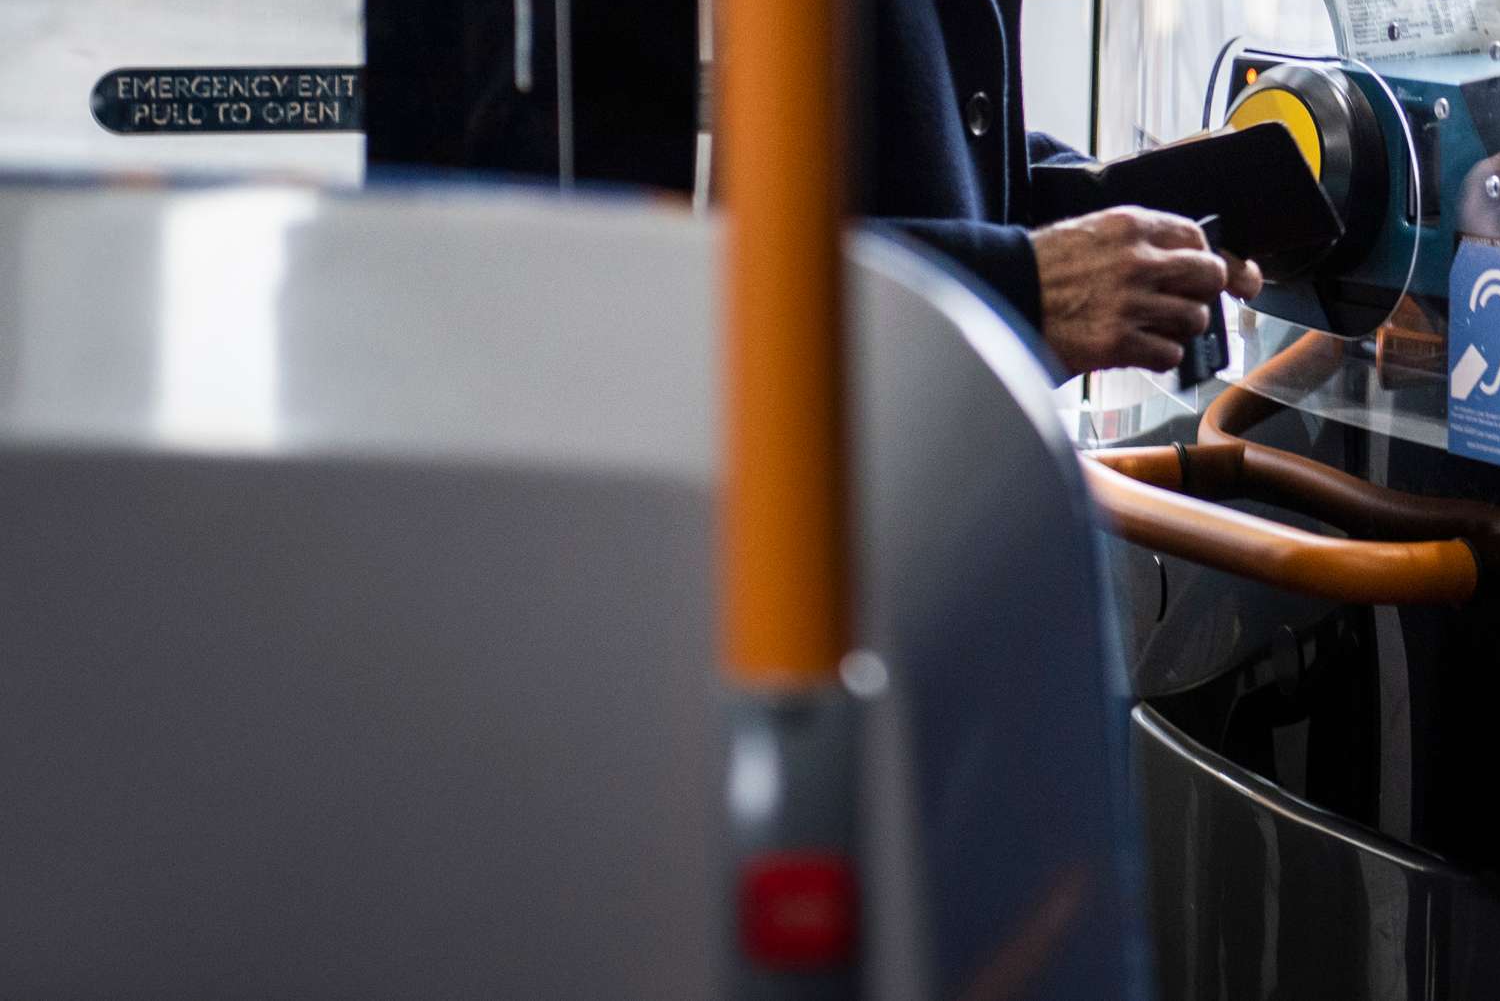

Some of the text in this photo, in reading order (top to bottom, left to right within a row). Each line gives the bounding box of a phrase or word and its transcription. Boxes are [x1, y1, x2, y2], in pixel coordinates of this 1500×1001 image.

[117, 74, 358, 99] EMERGENCY EXIT
[133, 101, 340, 126] PULL TO OPEN
